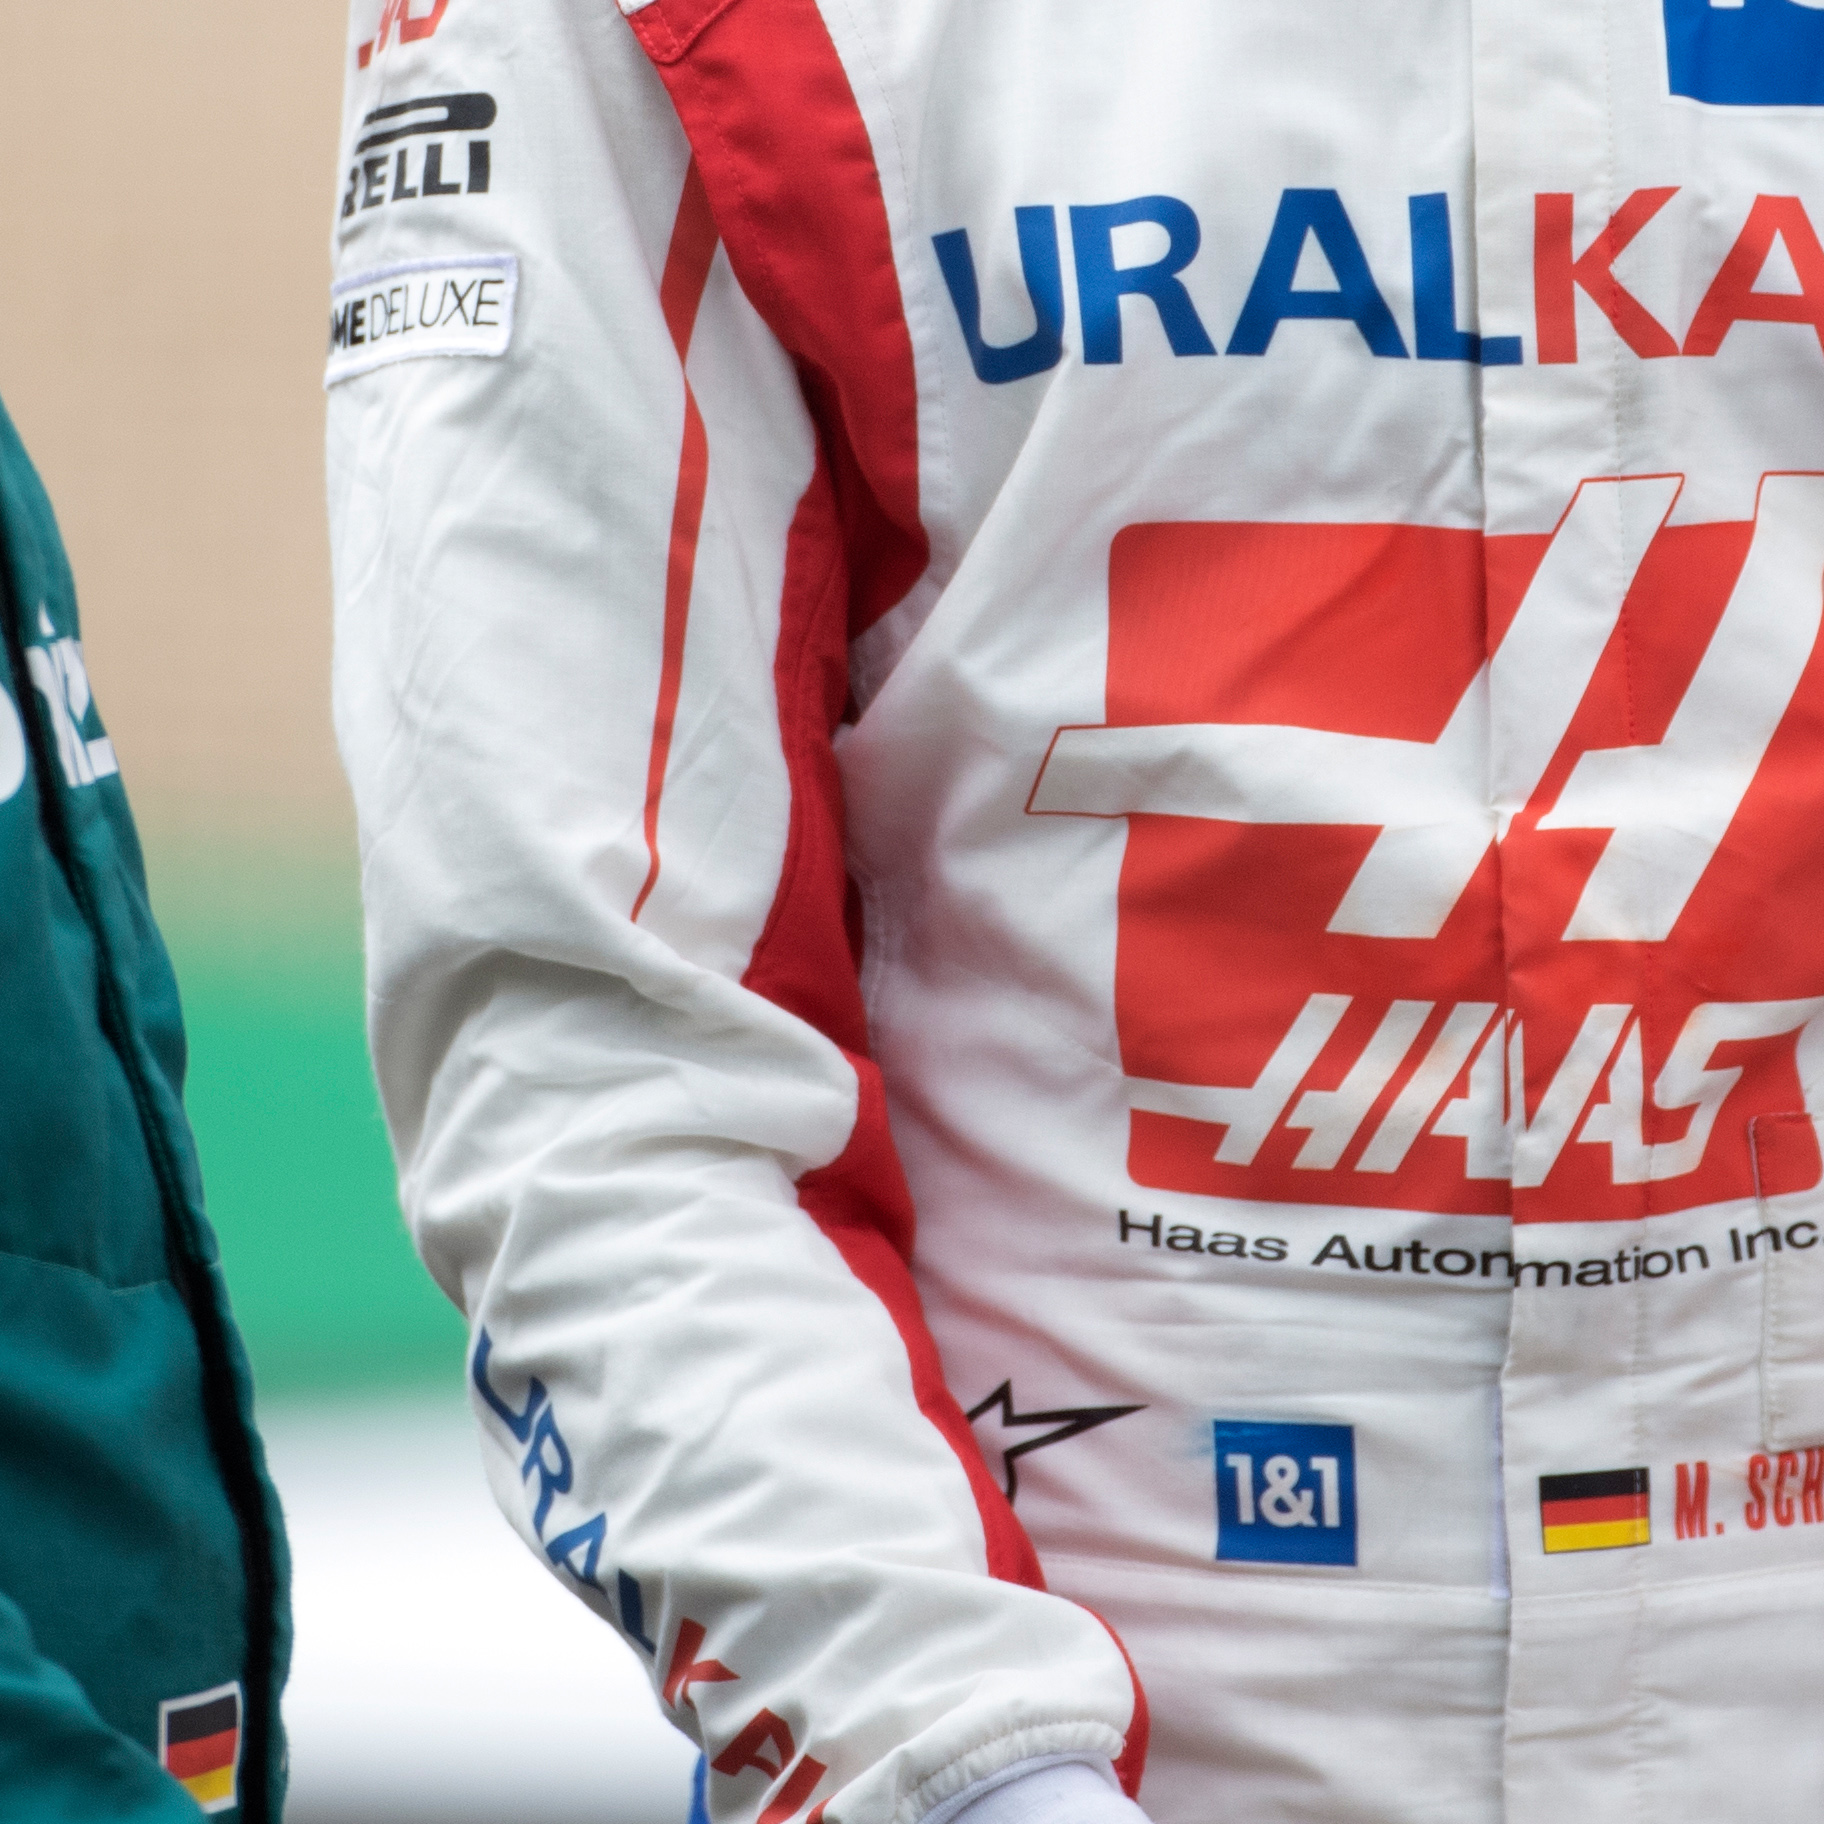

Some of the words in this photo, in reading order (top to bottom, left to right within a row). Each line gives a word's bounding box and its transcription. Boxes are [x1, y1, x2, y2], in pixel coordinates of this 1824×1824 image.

[329, 279, 505, 352] MEDELUXE
[1118, 1209, 1288, 1262] Haas
[1224, 1451, 1343, 1528] 1&1
[1675, 1461, 1725, 1540] M.
